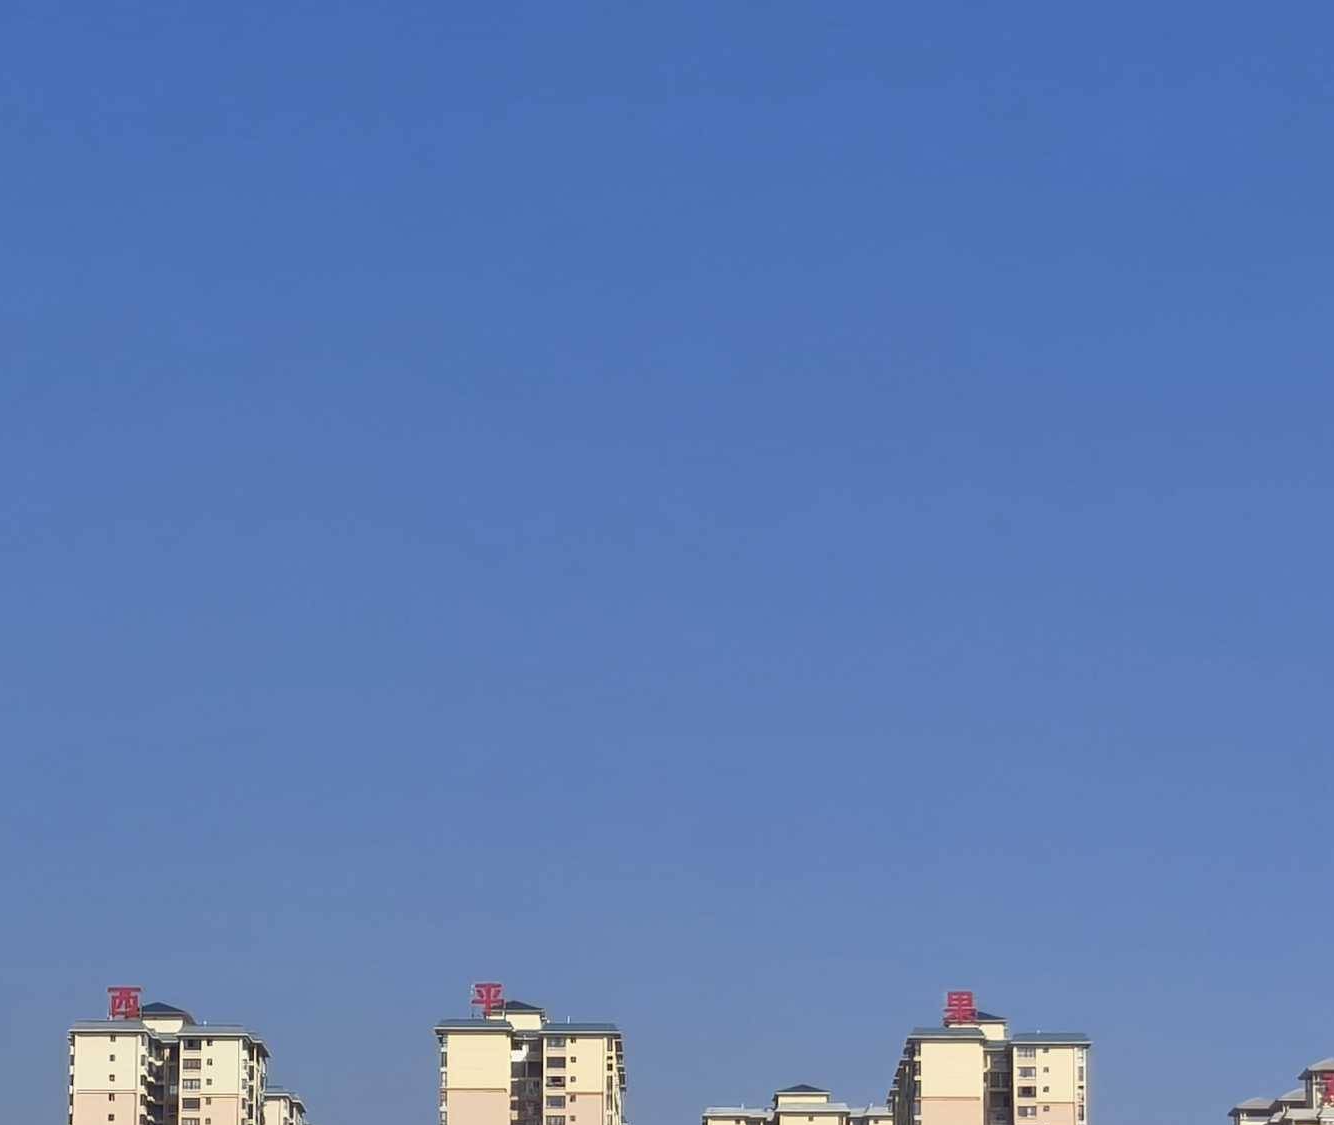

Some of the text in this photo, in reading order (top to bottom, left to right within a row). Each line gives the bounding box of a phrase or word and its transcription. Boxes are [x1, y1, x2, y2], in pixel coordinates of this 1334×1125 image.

[107, 986, 140, 1018] 西
[471, 983, 504, 1017] 平
[943, 991, 977, 1025] 果
